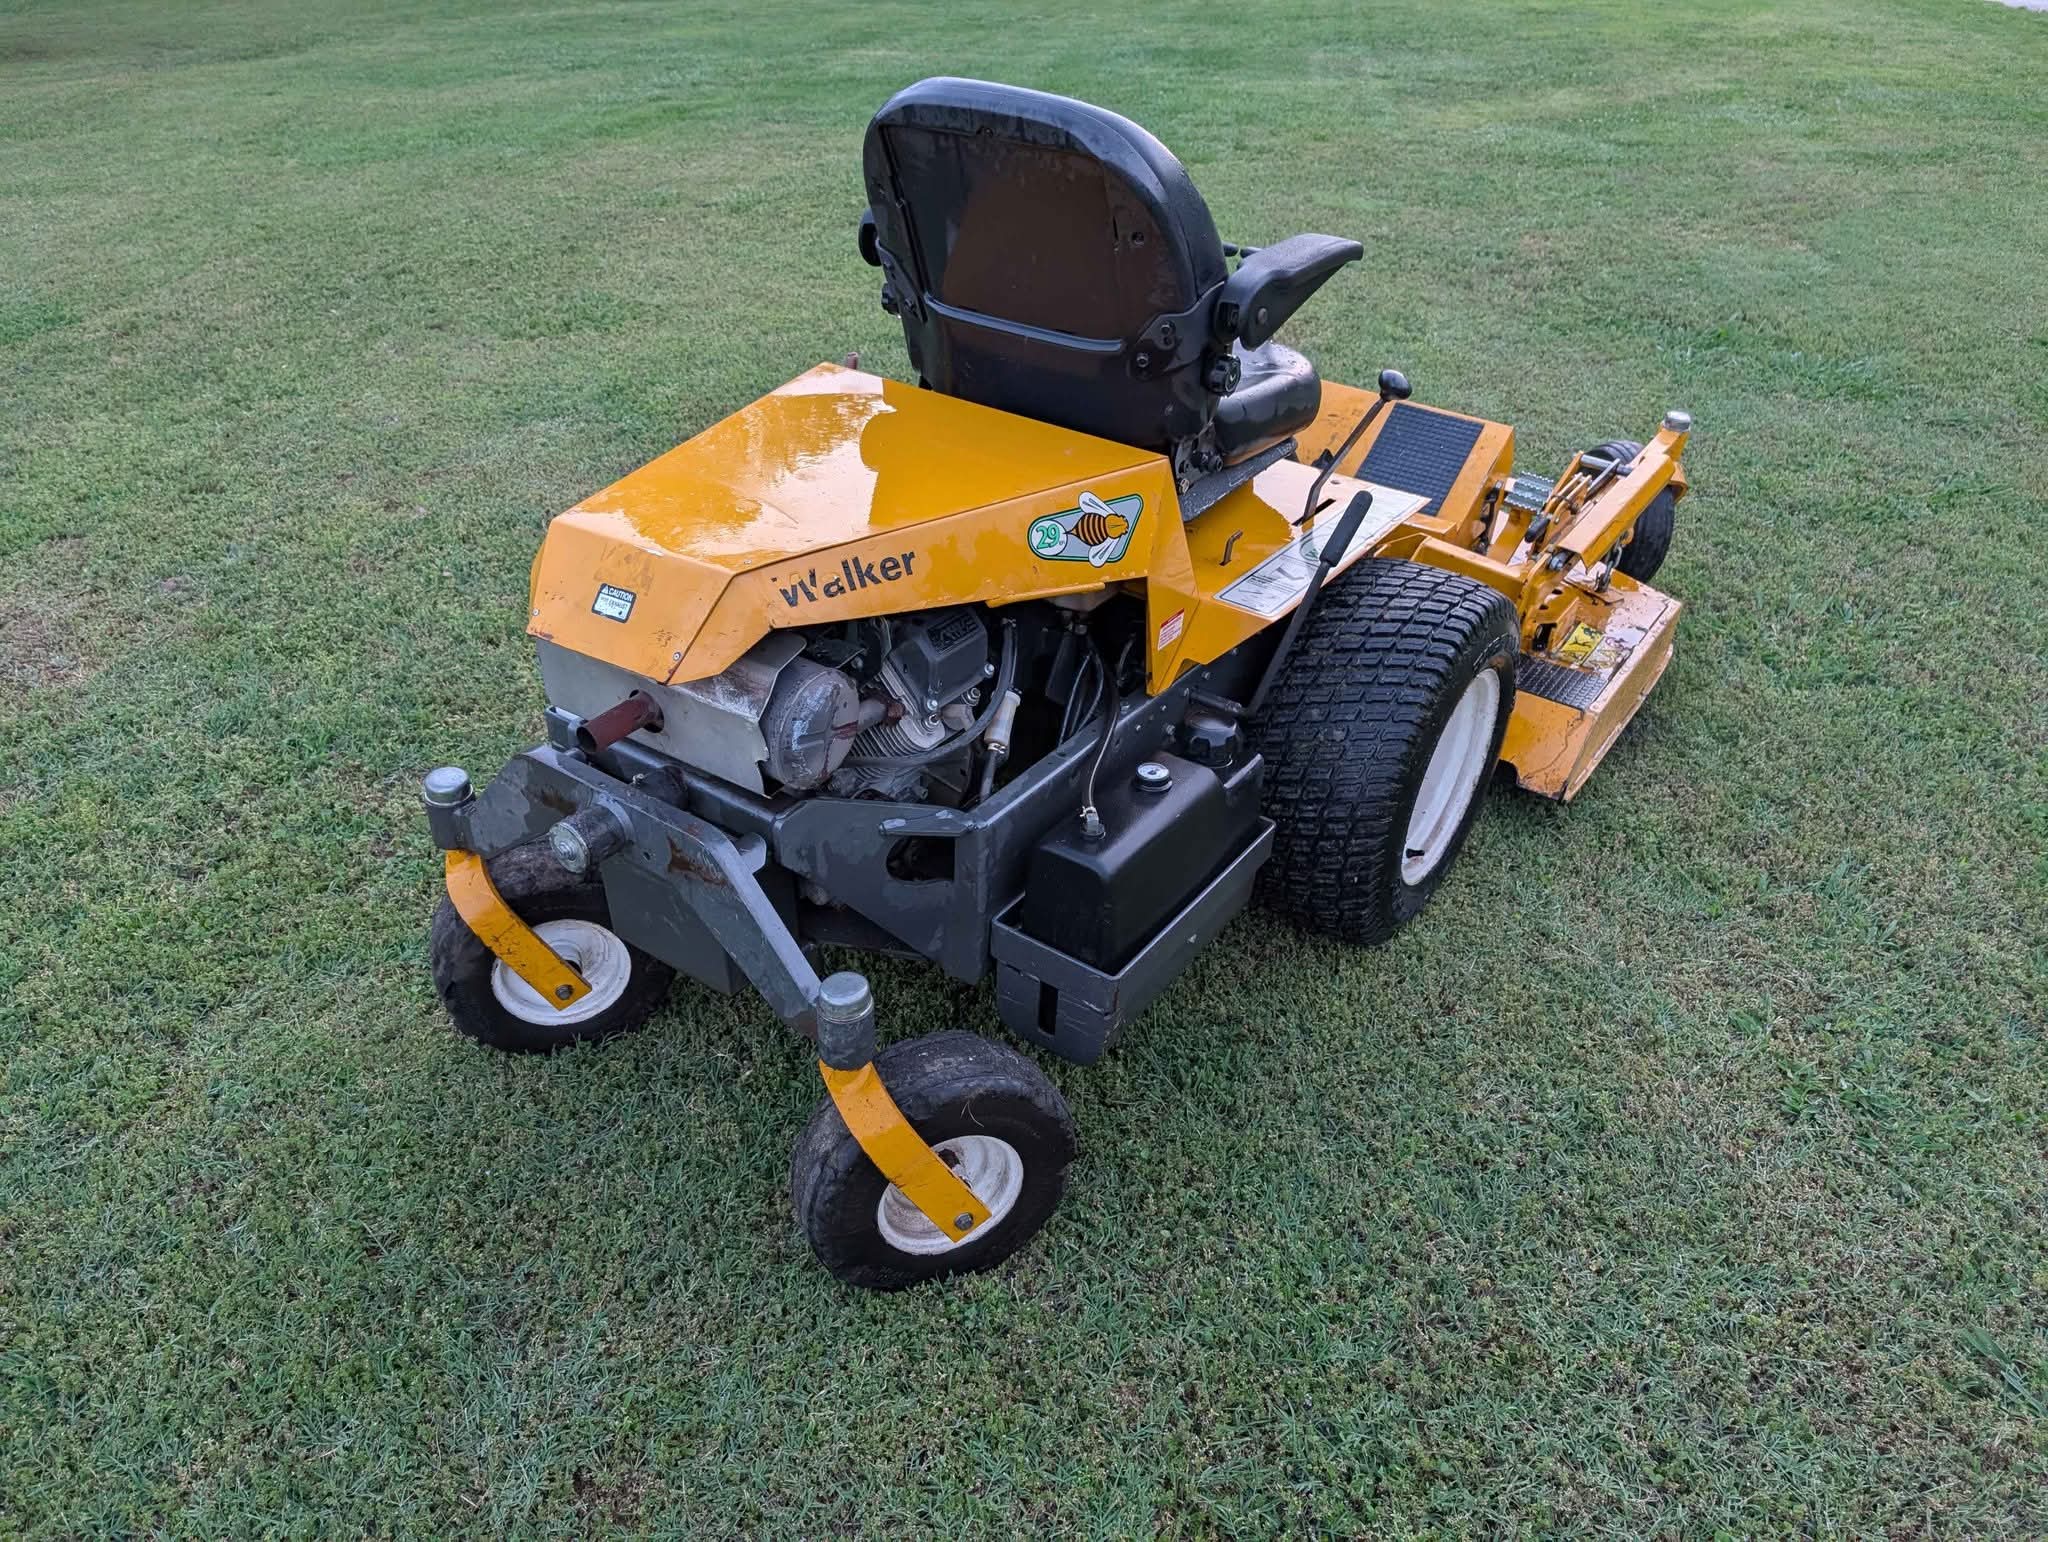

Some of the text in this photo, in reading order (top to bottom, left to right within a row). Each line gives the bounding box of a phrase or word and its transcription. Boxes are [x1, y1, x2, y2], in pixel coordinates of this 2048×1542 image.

[1035, 523, 1061, 550] 29
[771, 551, 916, 607] Walker
[609, 587, 634, 602] CAUTION
